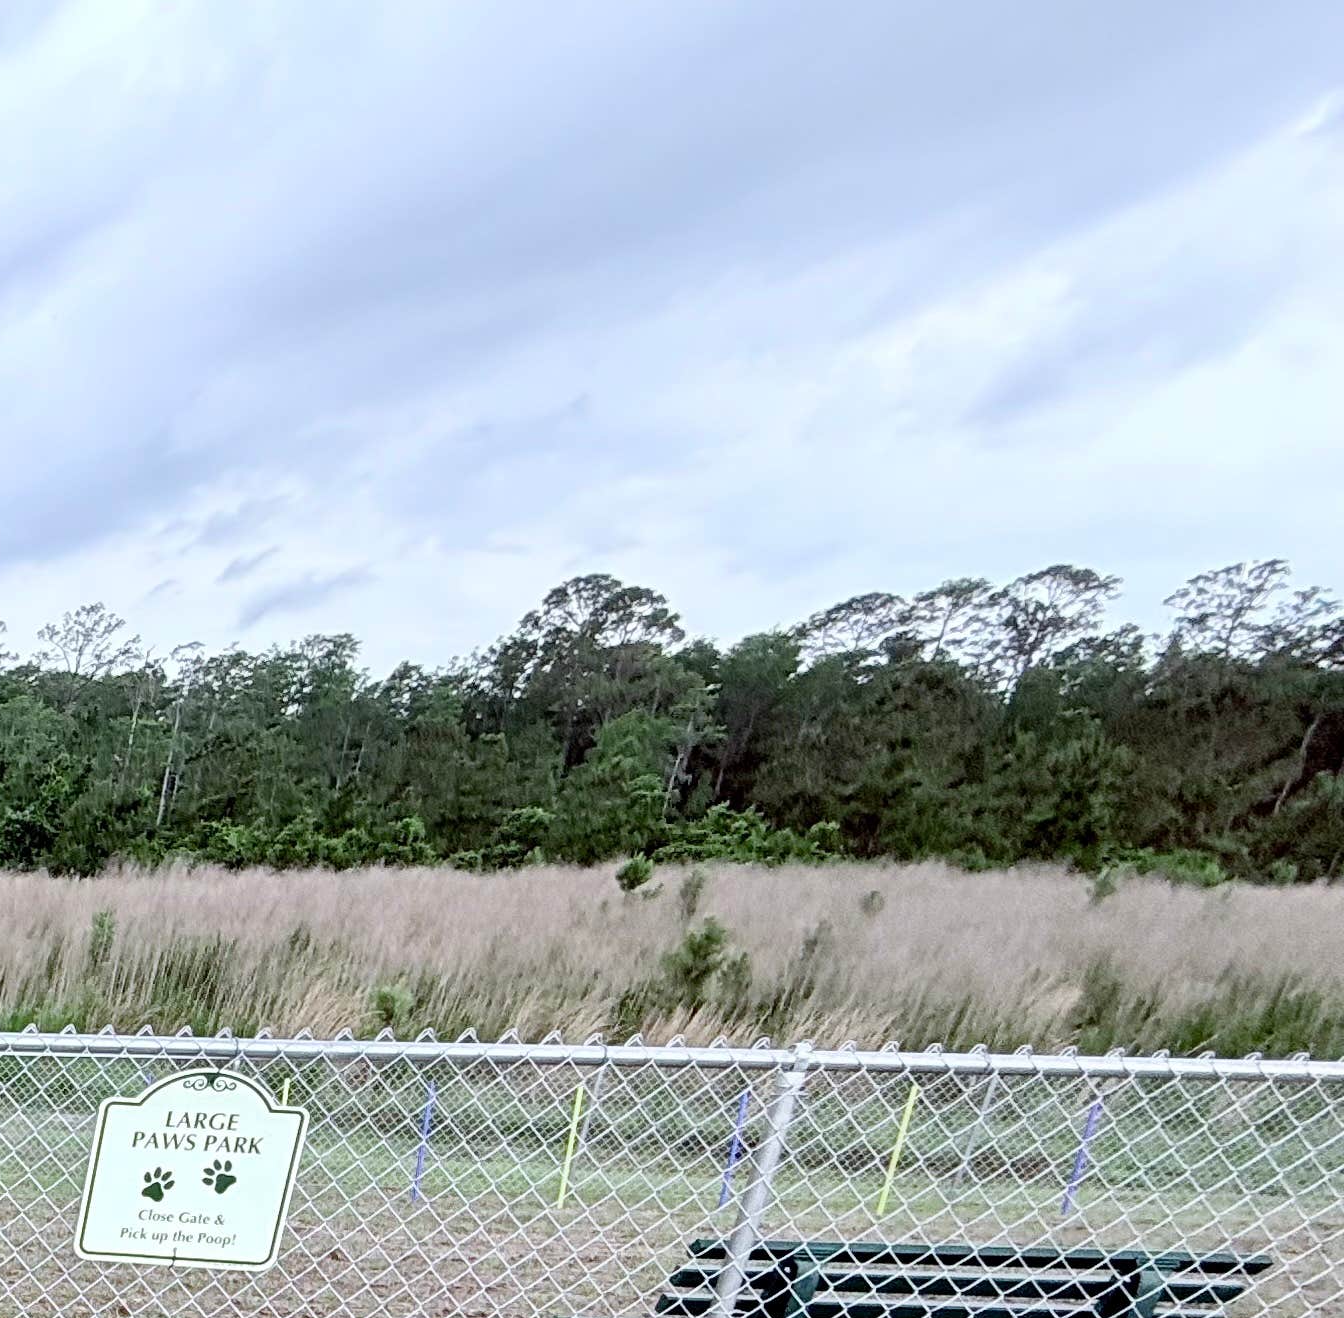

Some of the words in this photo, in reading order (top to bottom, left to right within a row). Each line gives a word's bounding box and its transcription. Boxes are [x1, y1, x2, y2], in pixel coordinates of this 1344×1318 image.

[165, 1110, 240, 1131] LARGE
[131, 1131, 197, 1151] PAWS
[203, 1134, 264, 1154] PARK
[137, 1209, 175, 1223] Close
[178, 1211, 211, 1225] Gate
[214, 1214, 226, 1226] &
[119, 1227, 147, 1240] Pick
[151, 1231, 169, 1242] up
[172, 1229, 194, 1243] the
[197, 1232, 237, 1247] Poop!
